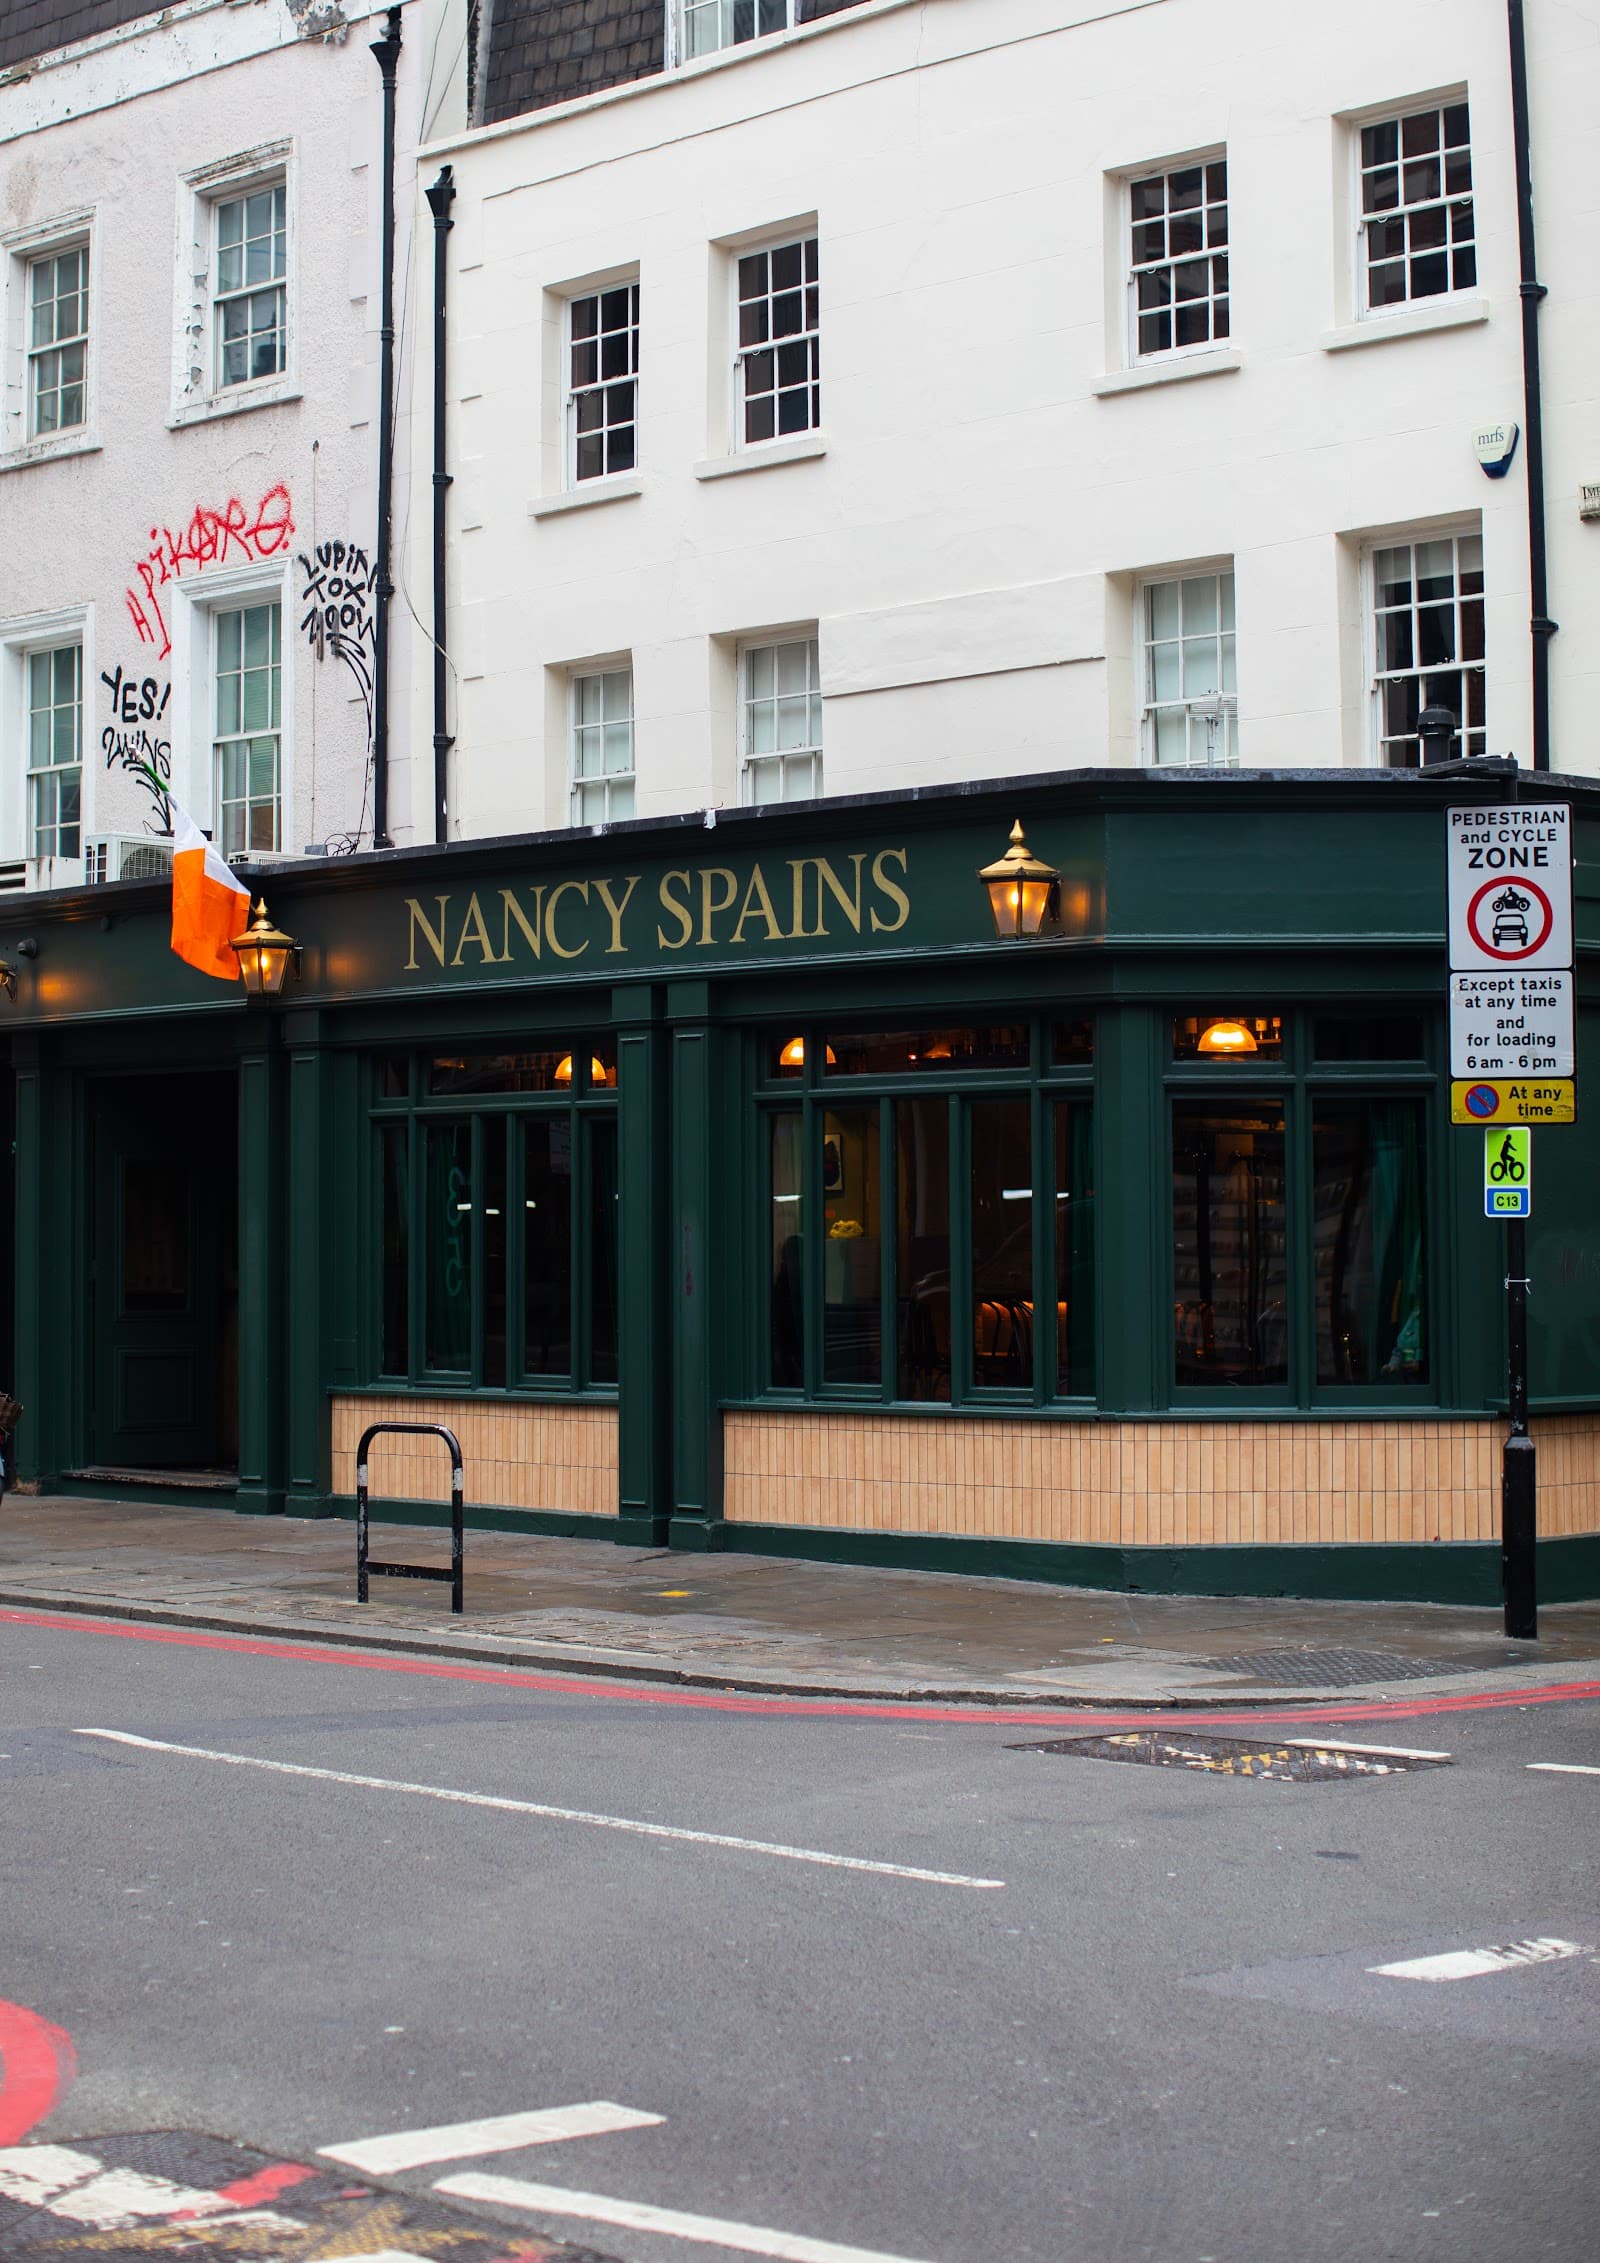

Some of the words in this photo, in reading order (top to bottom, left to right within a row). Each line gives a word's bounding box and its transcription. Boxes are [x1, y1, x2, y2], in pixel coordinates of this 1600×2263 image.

[1478, 426, 1504, 445] mrfs
[102, 664, 171, 722] YES!
[1452, 811, 1565, 826] PEDESTRIAN
[1461, 831, 1490, 843] and
[1498, 829, 1557, 843] CYCLE
[1468, 847, 1549, 868] ZONE
[403, 875, 641, 970] NANCY
[658, 848, 910, 950] SPAINS
[1459, 978, 1515, 993] Except
[1520, 977, 1562, 991] taxis
[1465, 995, 1481, 1008] at
[1487, 996, 1515, 1010] any
[1521, 994, 1557, 1008] time
[1496, 1016, 1525, 1029] and
[1467, 1034, 1490, 1047] for
[1497, 1032, 1556, 1048] loading
[1508, 1086, 1528, 1099] At
[1533, 1088, 1562, 1102] any
[1518, 1103, 1553, 1116] time
[1496, 1195, 1519, 1208] C13
